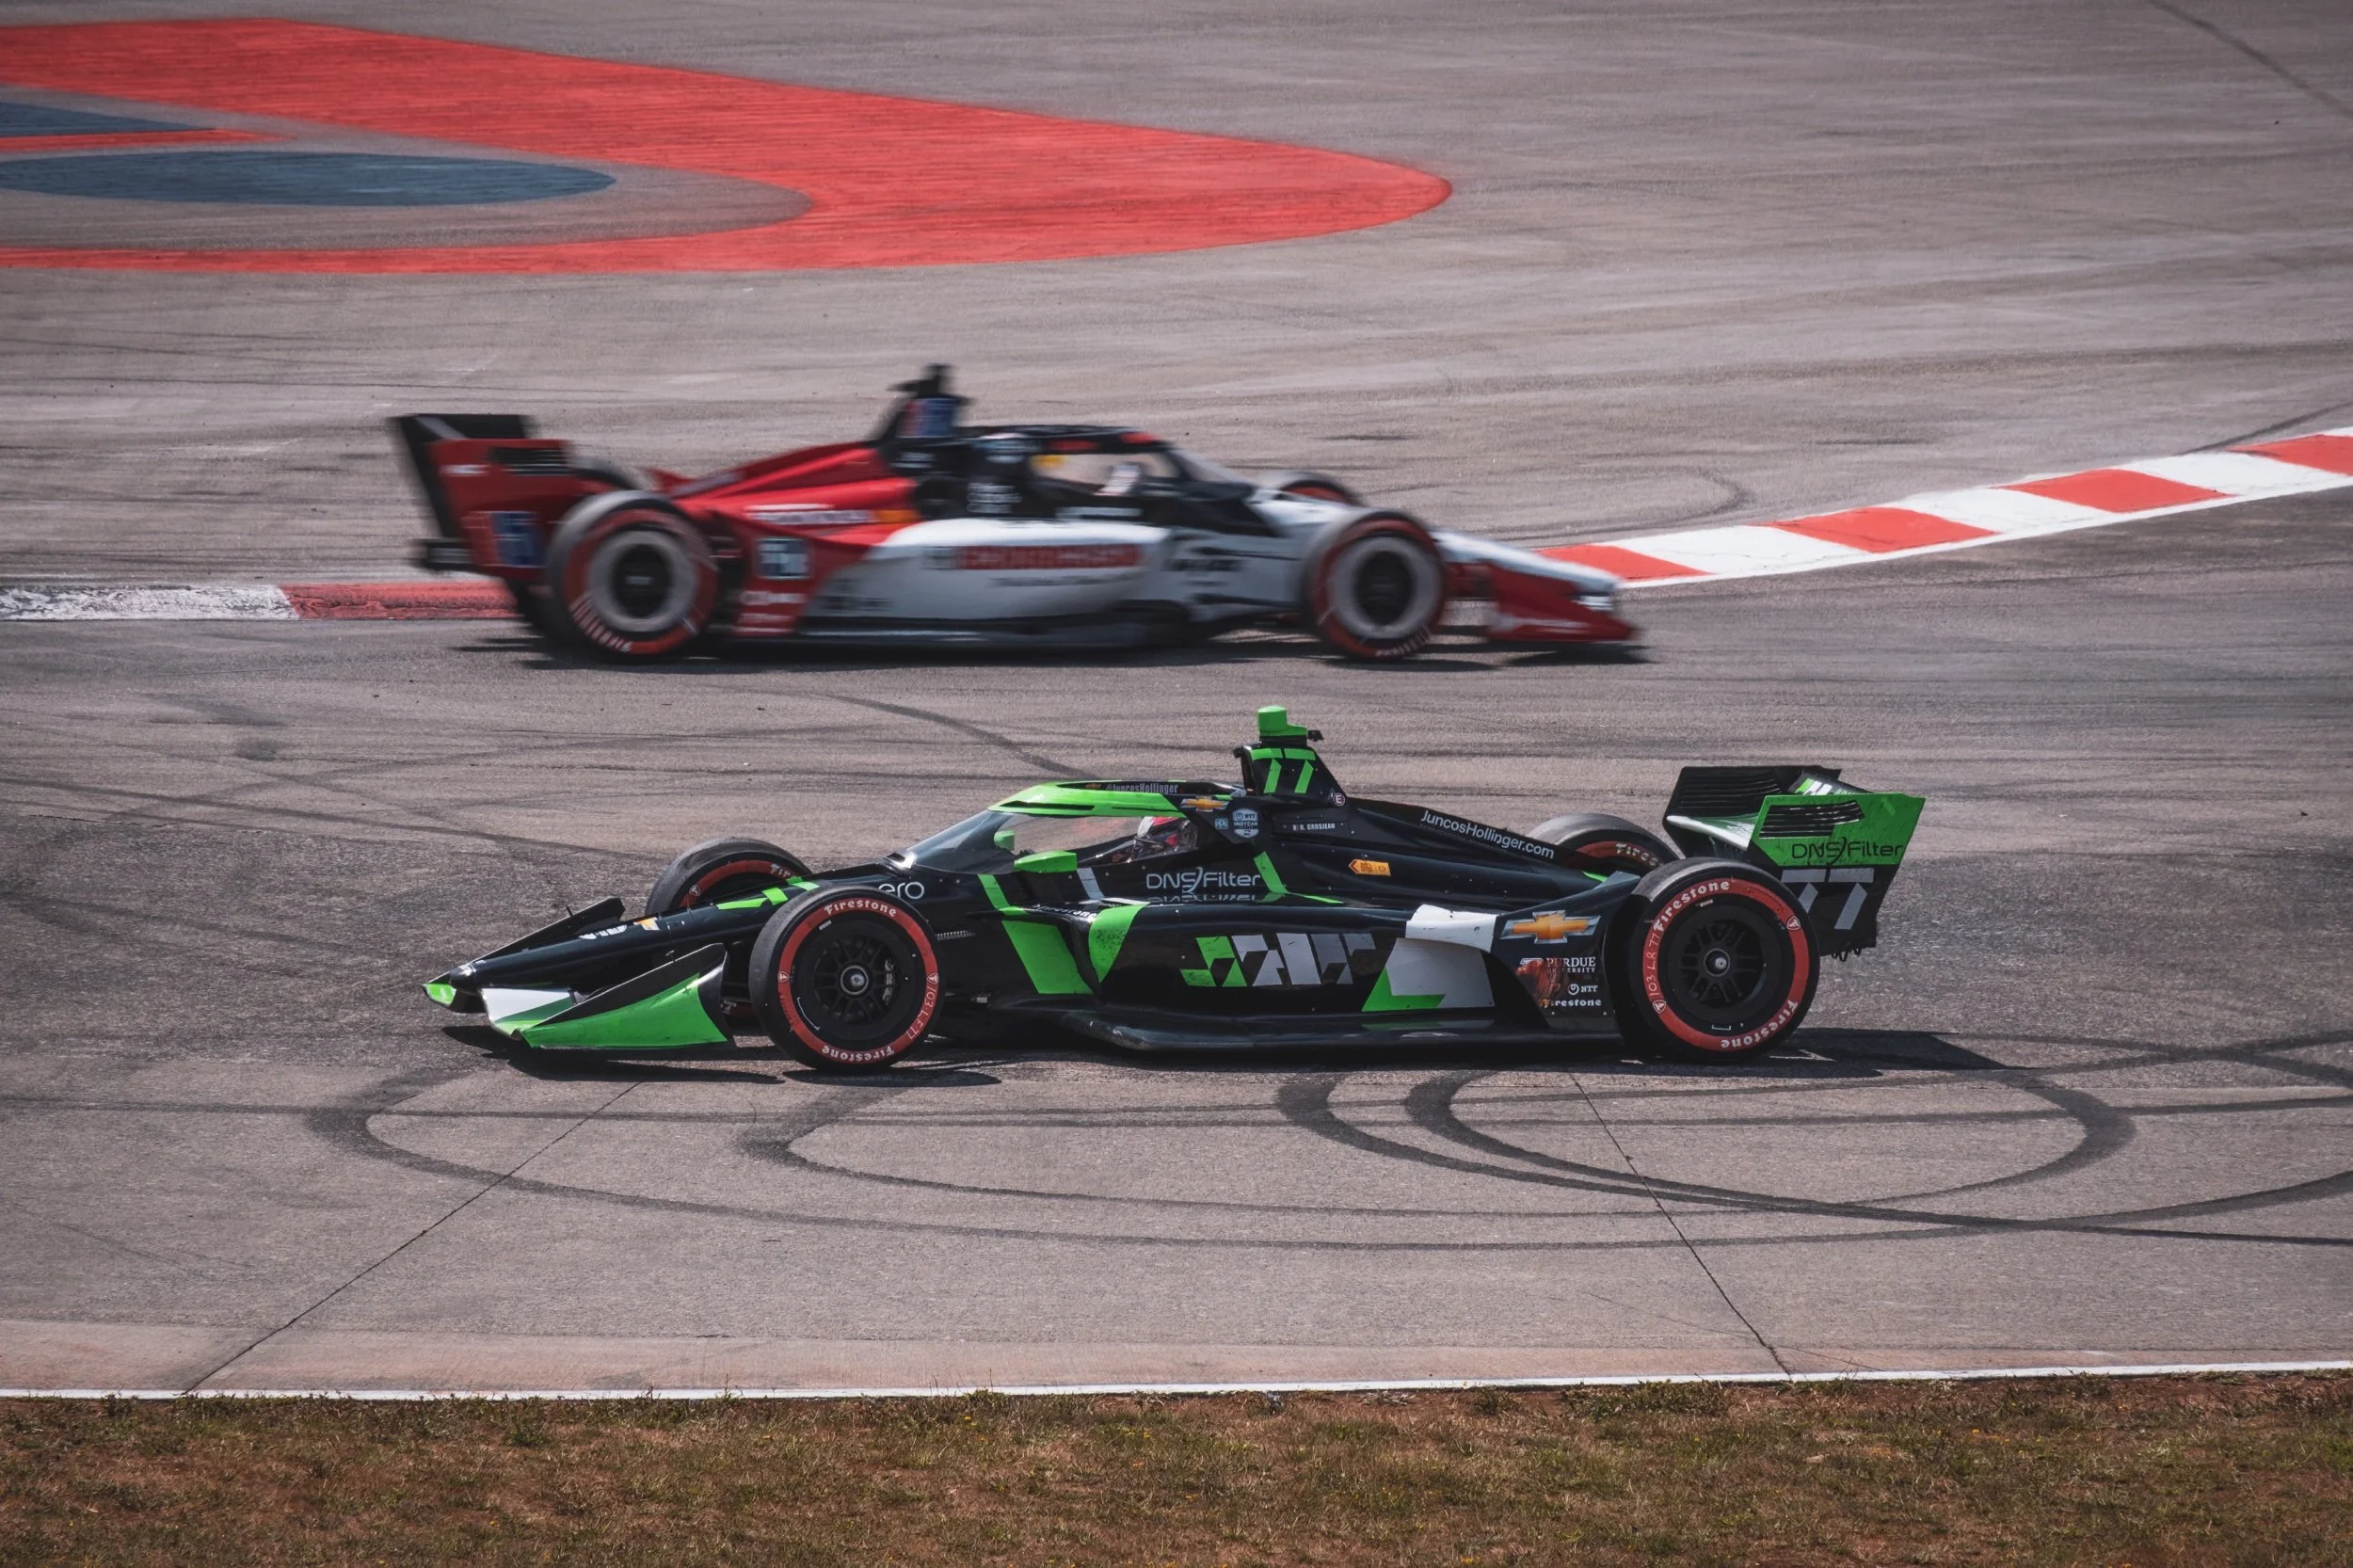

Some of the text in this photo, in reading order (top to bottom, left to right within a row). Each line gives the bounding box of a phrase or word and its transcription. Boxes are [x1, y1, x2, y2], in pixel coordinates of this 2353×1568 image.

[1250, 747, 1316, 794] 77
[1306, 823, 1336, 831] GROSJEAN
[1420, 809, 1555, 859] JuncosHollinger.com
[824, 899, 897, 918] Firestone
[1653, 880, 1731, 933] Firestone
[1721, 999, 1799, 1049] Firestone
[821, 1045, 896, 1063] Firestone
